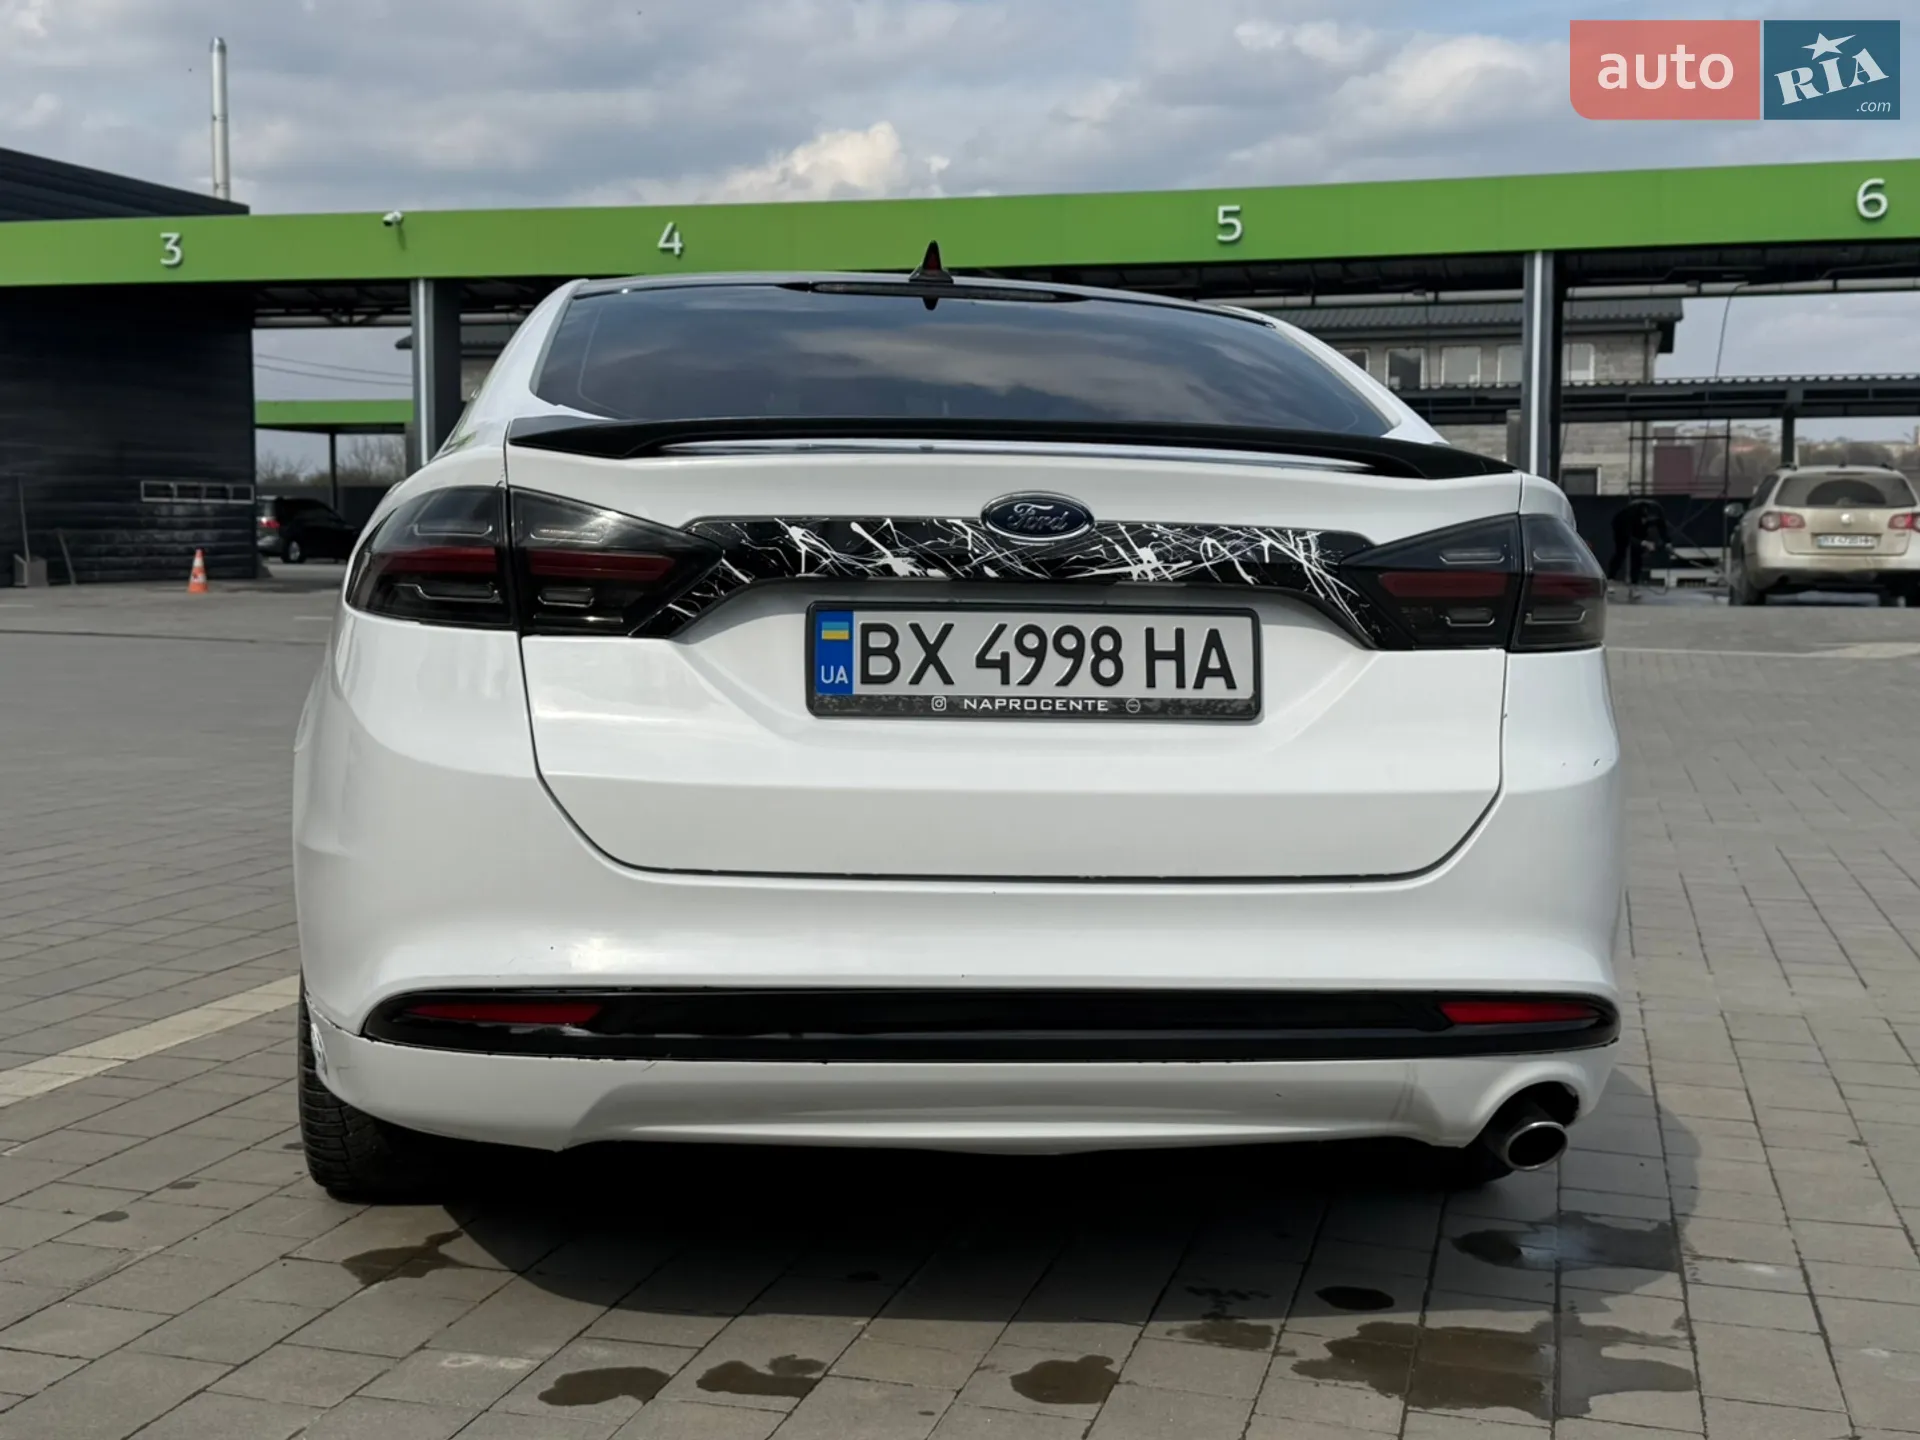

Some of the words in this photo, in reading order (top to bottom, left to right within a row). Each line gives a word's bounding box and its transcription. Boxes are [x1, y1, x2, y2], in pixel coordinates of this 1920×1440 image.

[1857, 178, 1888, 218] 6
[658, 221, 683, 255] 4
[1217, 205, 1242, 241] 5
[160, 232, 182, 265] 3
[1007, 503, 1069, 531] Ford
[859, 622, 955, 686] BX
[975, 623, 1124, 687] 4998
[1144, 626, 1238, 690] HA
[820, 665, 849, 685] UA
[963, 698, 1109, 711] NAPROCENTE
